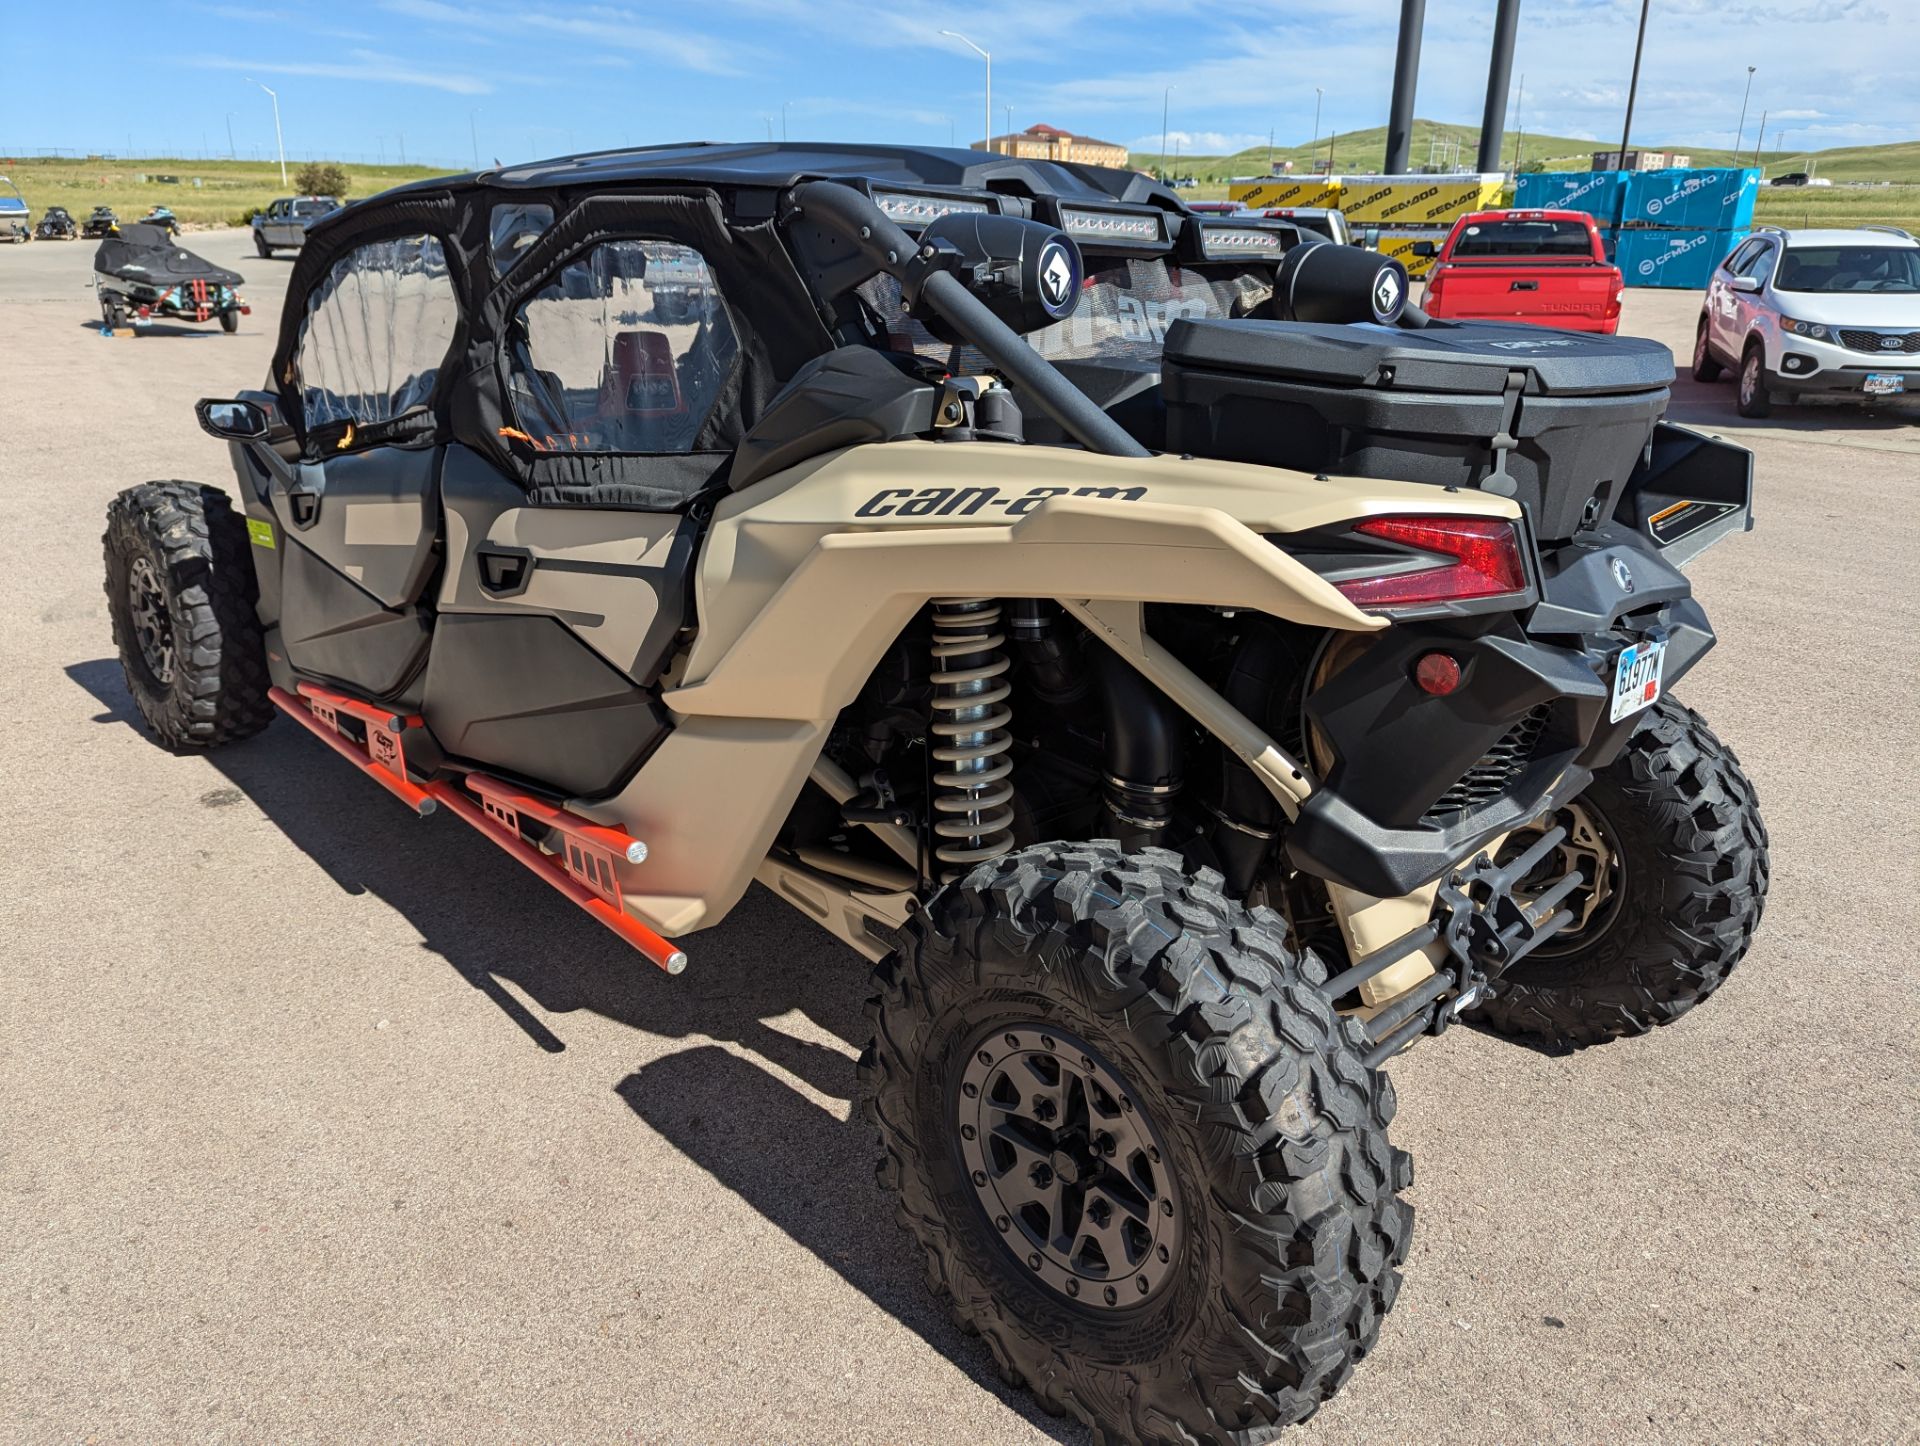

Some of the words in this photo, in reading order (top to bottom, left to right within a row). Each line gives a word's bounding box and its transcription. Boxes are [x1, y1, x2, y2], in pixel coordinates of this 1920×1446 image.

[1558, 176, 1605, 208] CFMOTO
[1663, 174, 1717, 206] CFMOTO
[1655, 235, 1708, 266] CFMOTO
[1542, 303, 1601, 312] TUNDRA
